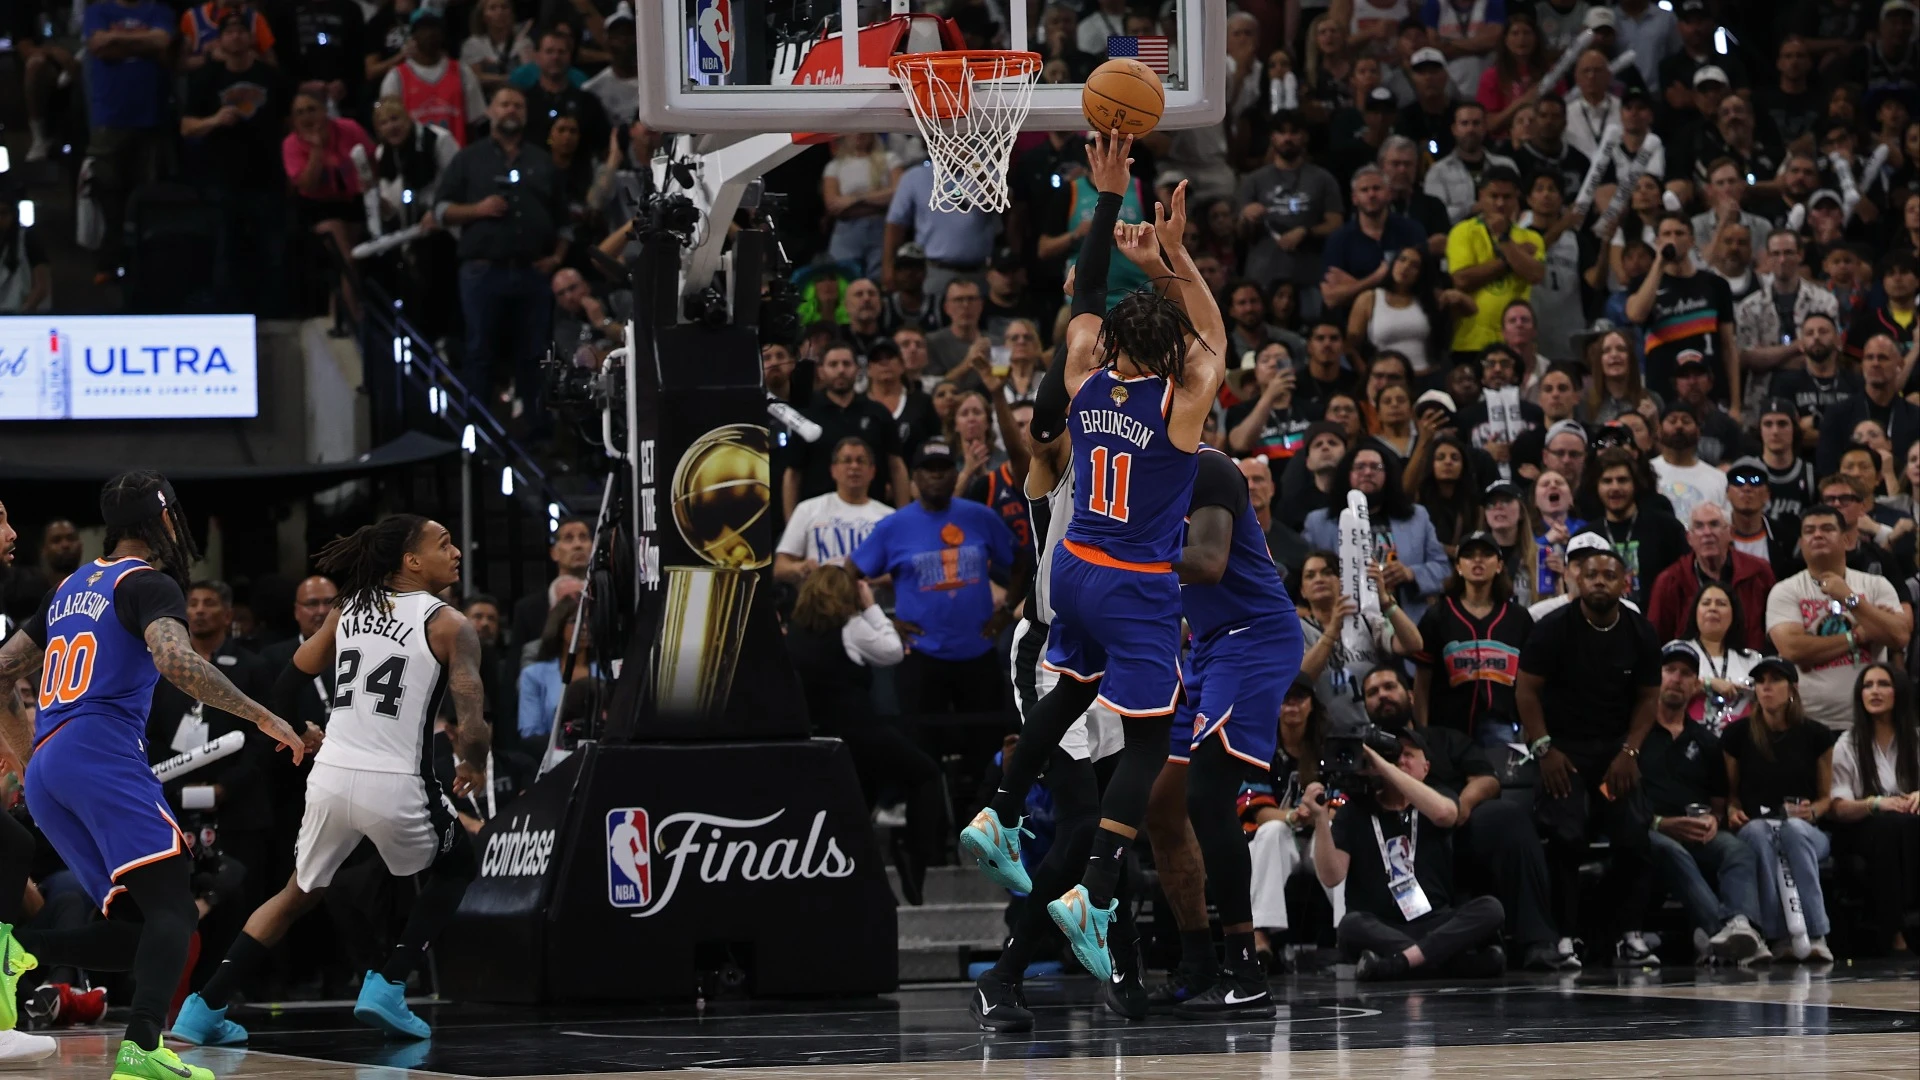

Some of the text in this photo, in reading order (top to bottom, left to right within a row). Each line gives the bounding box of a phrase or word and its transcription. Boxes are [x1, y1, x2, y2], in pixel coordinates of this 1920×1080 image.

[702, 57, 719, 70] NBA
[85, 346, 232, 375] ULTRA
[1079, 409, 1154, 450] BRUNSON
[1089, 445, 1132, 524] 11
[48, 591, 110, 627] CLARKSON
[342, 615, 413, 647] VASSELL
[38, 631, 98, 711] 00
[333, 647, 410, 720] 24
[481, 813, 556, 878] coinbase
[615, 808, 855, 917] NBA Finals
